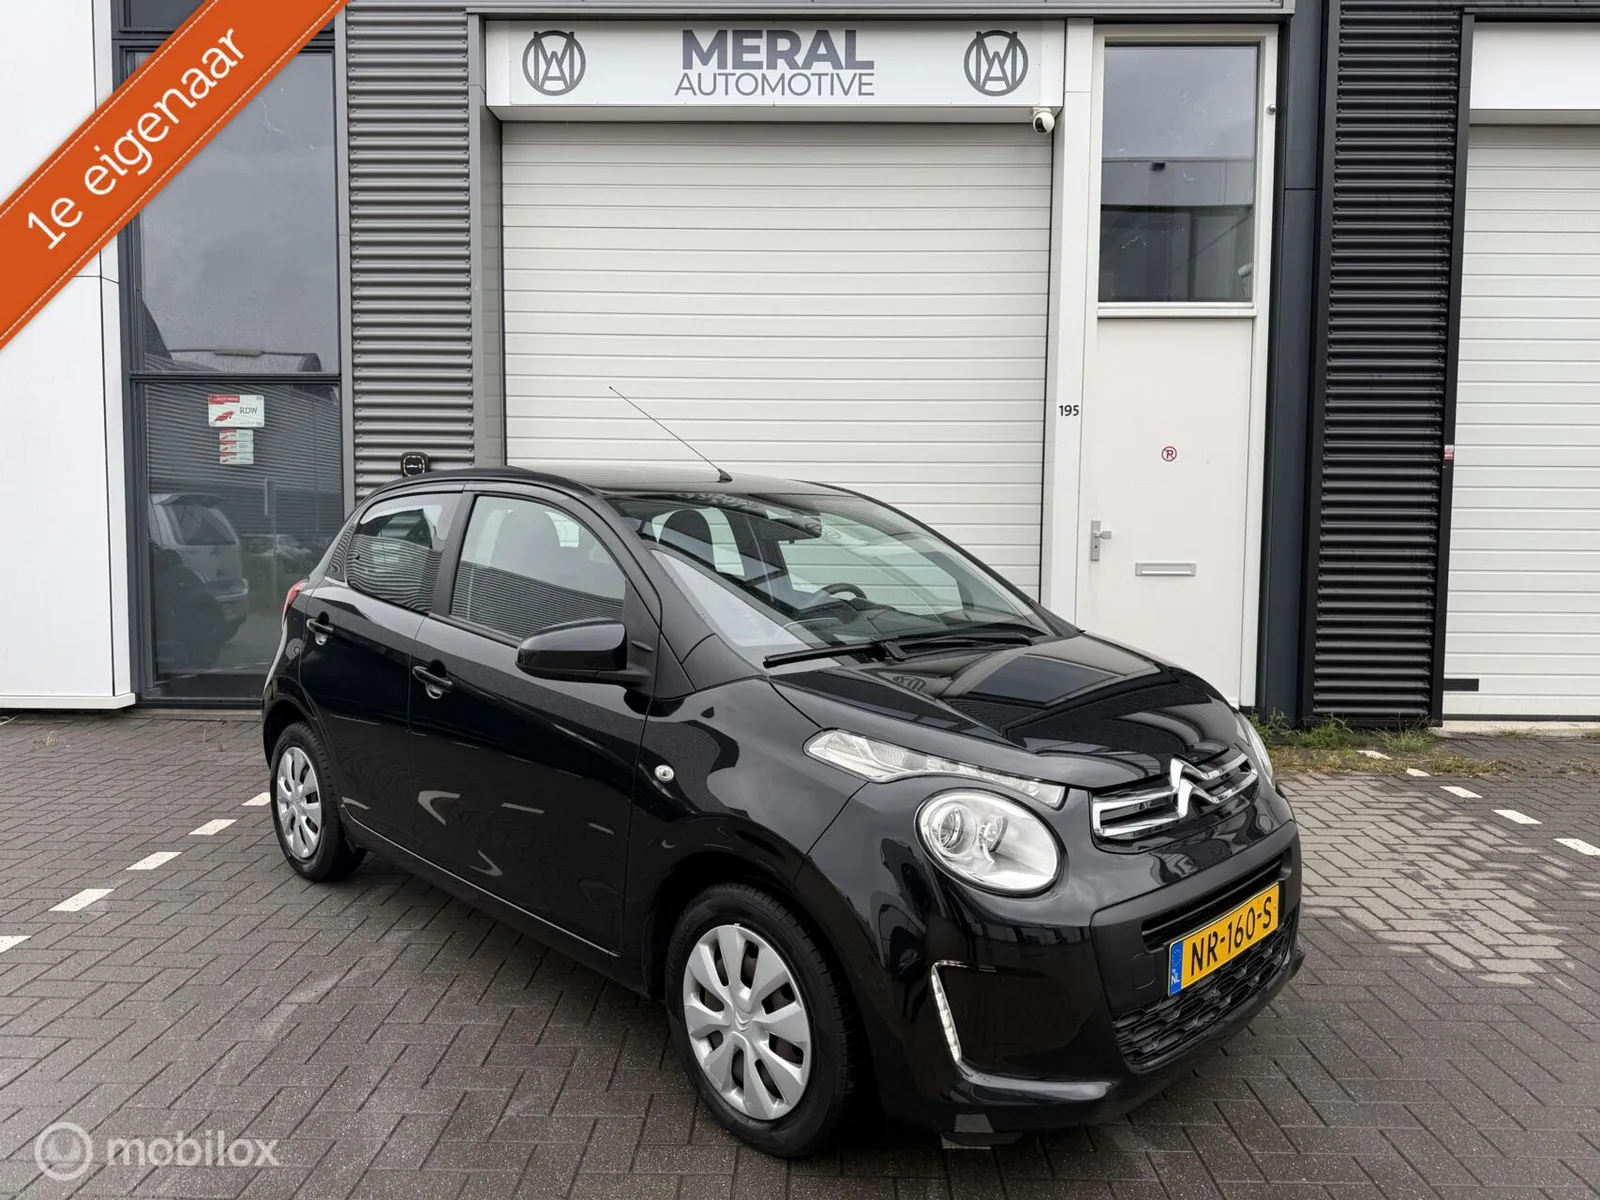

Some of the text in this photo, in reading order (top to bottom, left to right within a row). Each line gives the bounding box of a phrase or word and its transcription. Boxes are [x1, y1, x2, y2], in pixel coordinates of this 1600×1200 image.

[682, 29, 875, 70] MERAL
[674, 72, 875, 96] AUTOMOTIVE
[239, 406, 258, 415] RDW
[1058, 404, 1080, 417] 195
[1191, 895, 1273, 977] NR-160-S
[1171, 971, 1181, 986] NL
